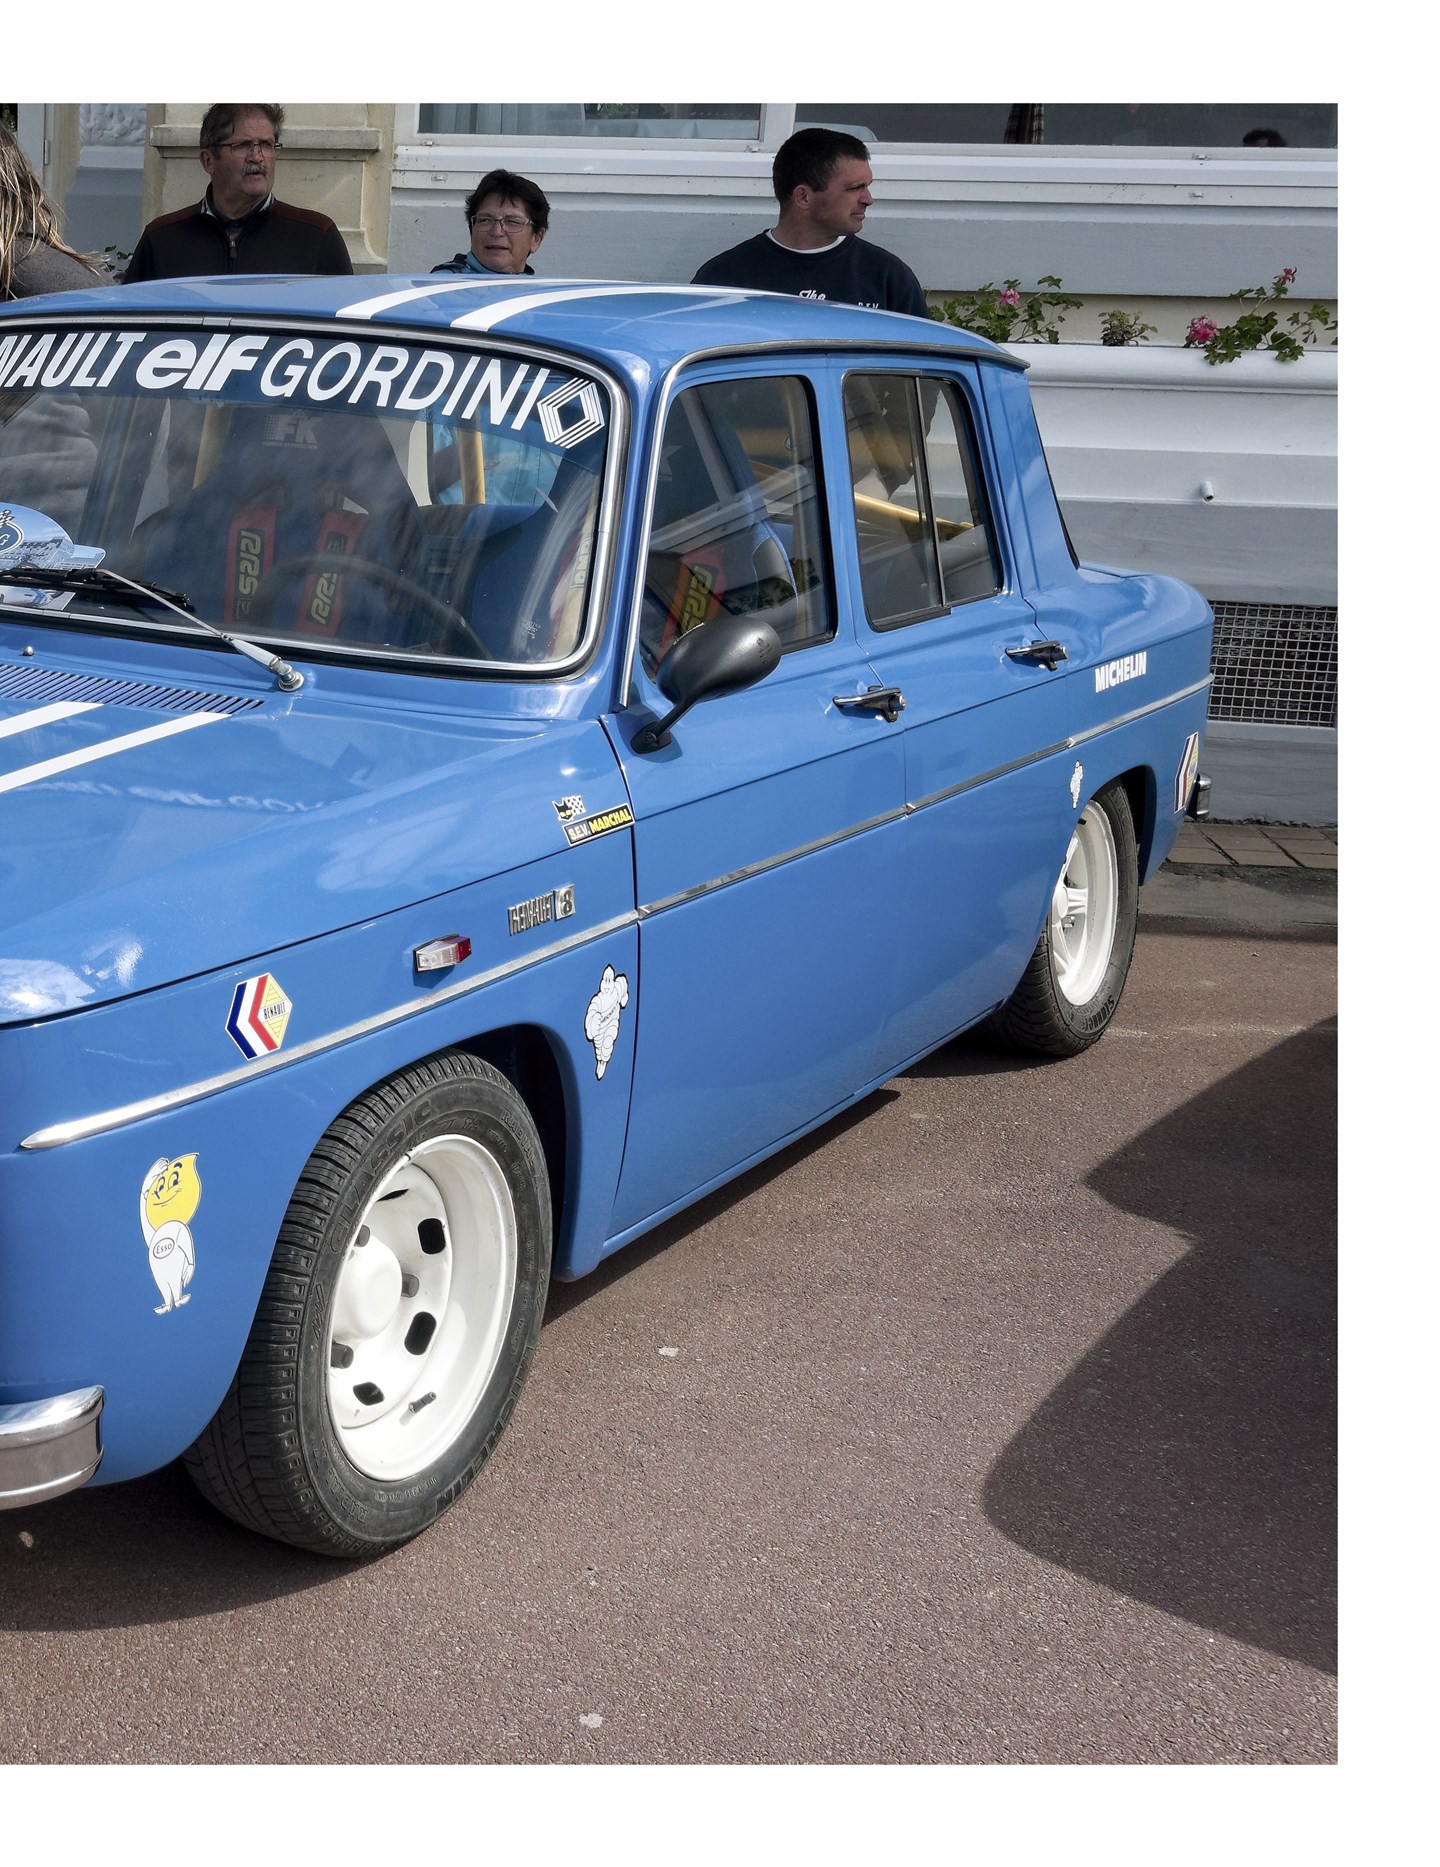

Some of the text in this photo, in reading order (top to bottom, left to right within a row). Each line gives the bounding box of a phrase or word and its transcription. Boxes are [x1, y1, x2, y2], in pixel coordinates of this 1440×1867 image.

[136, 333, 271, 392] elf
[261, 339, 551, 432] GORDINI
[238, 530, 261, 596] RRS
[311, 572, 338, 626] RR
[1094, 651, 1148, 694] MICHELIN
[569, 808, 632, 841] S.E.V. MARCHAL
[507, 892, 554, 936] RENAULT
[263, 1001, 286, 1021] RENAULT
[330, 1100, 431, 1253] CLASSIC
